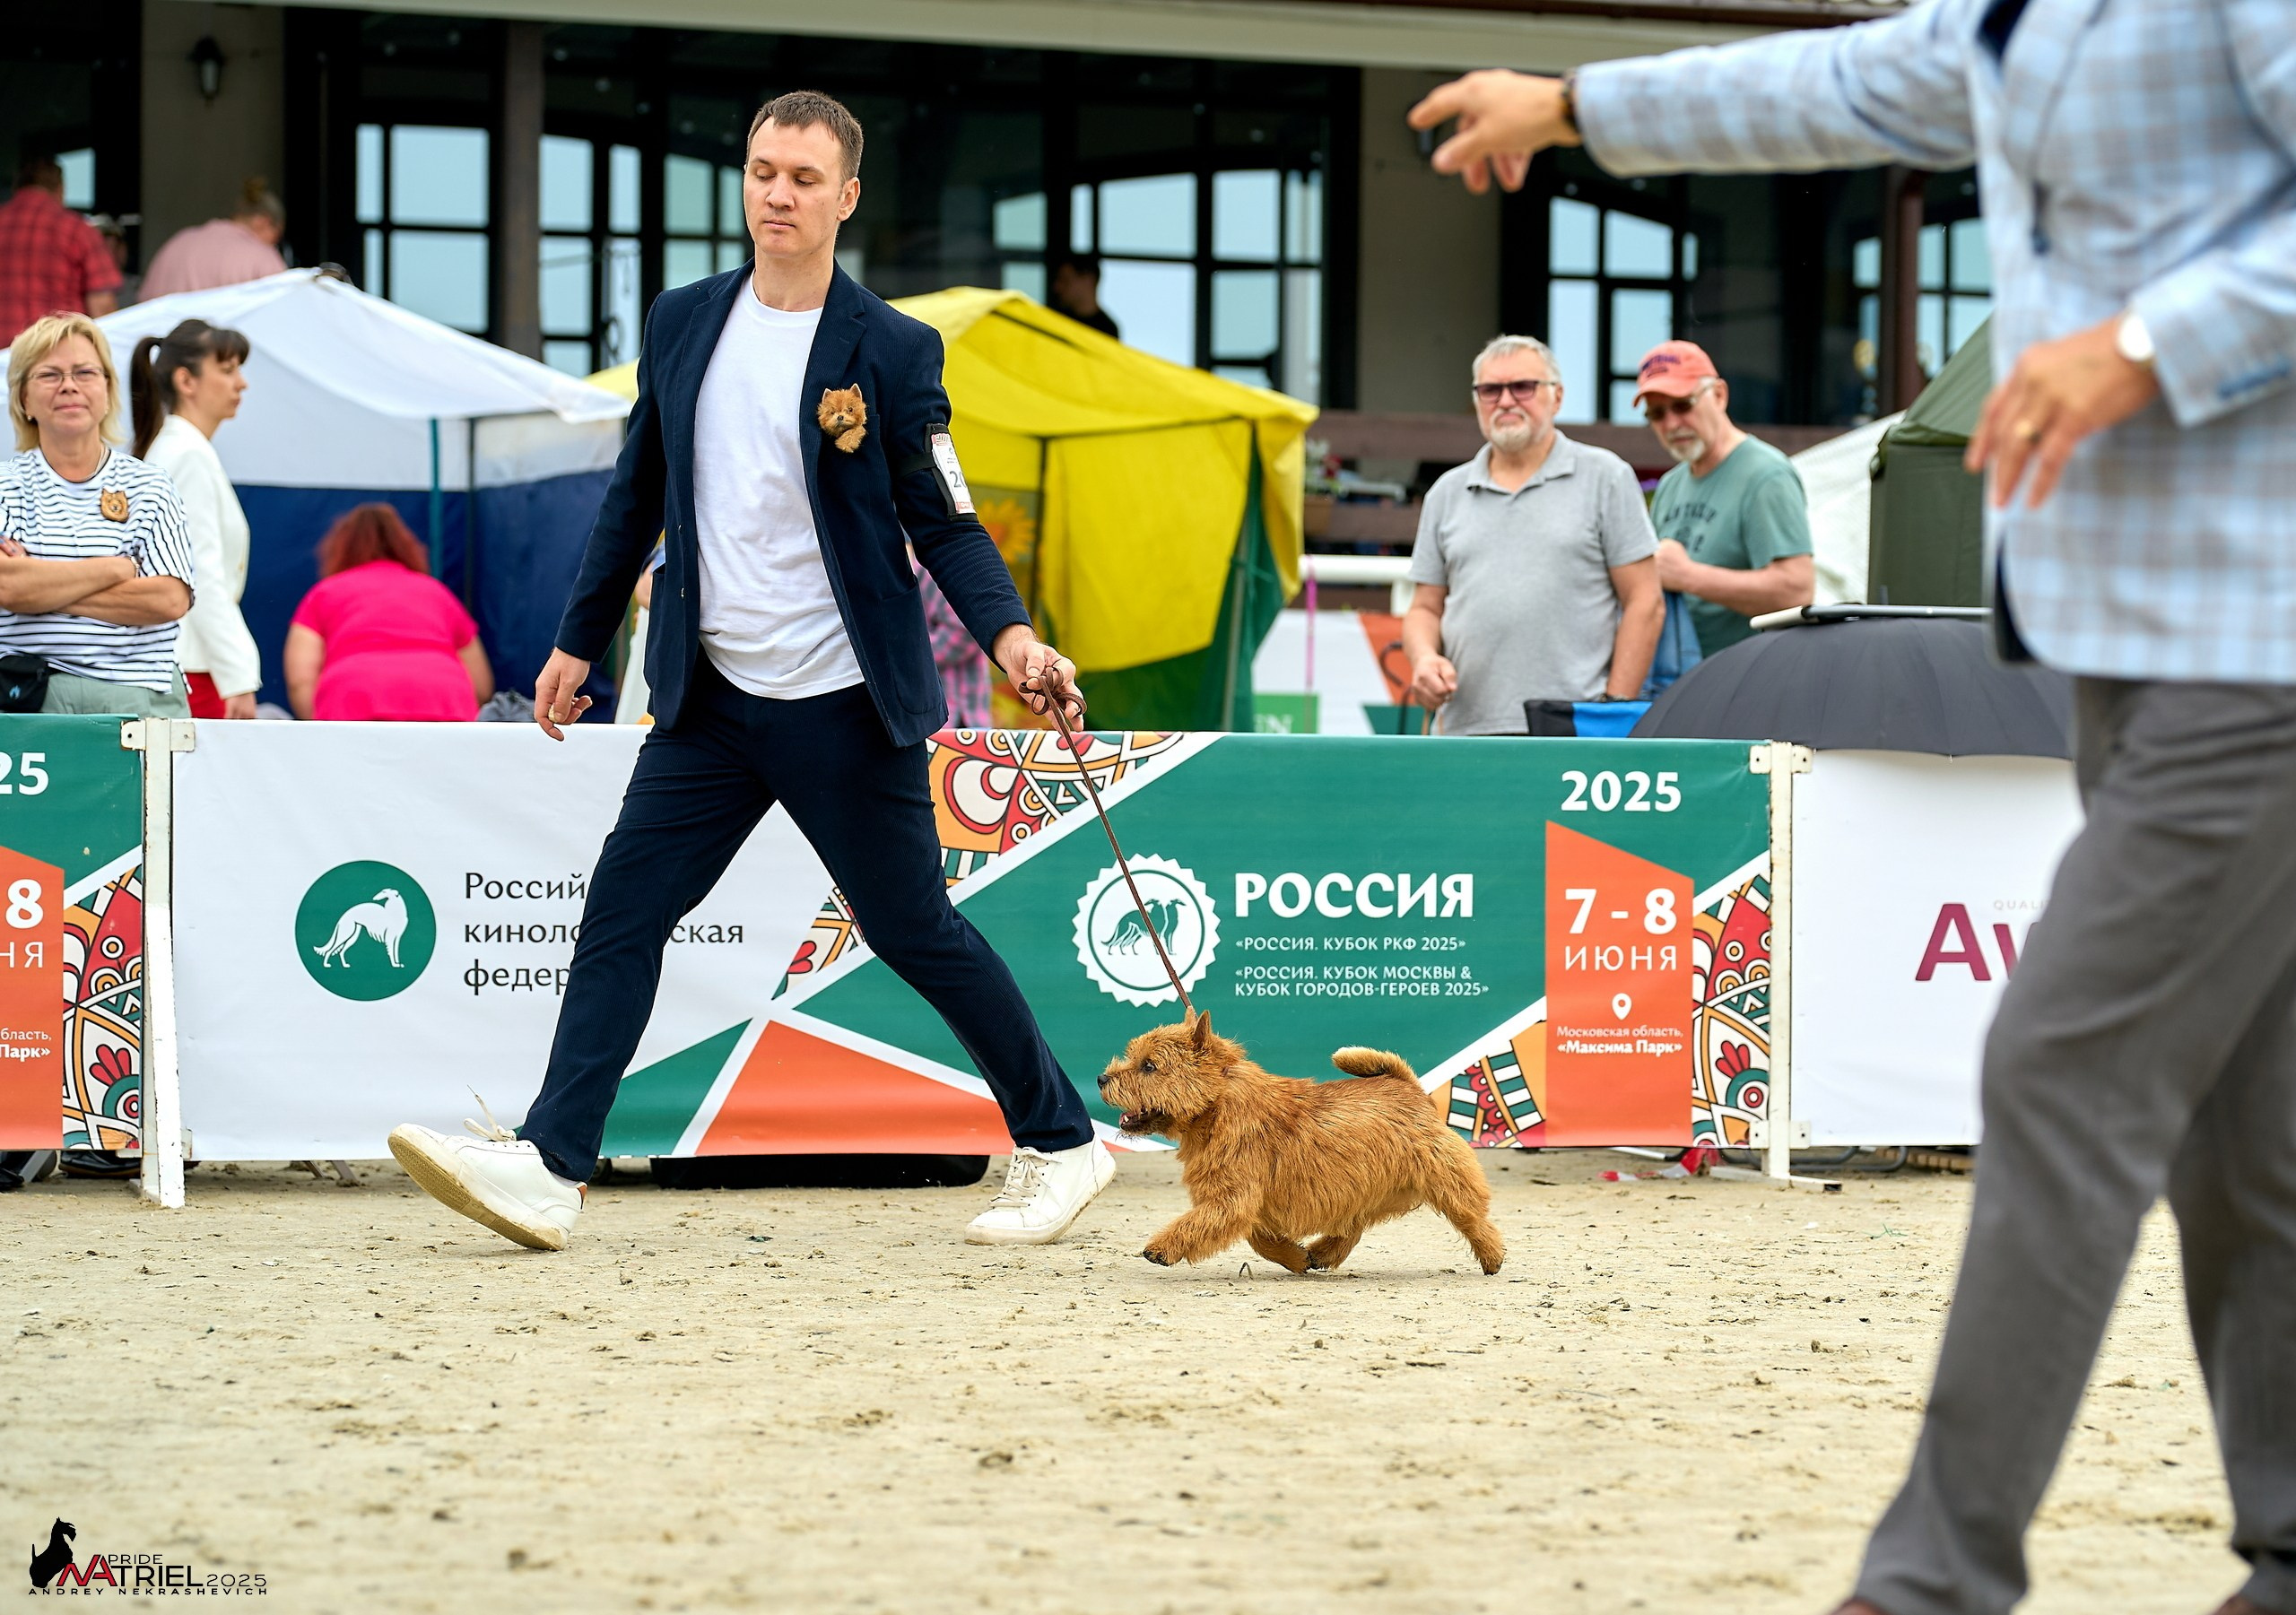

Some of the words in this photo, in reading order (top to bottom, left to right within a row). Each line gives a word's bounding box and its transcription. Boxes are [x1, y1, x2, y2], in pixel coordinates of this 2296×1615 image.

[1561, 770, 1682, 812] 2025
[465, 873, 585, 899] Россий
[1235, 873, 1474, 918] РОССИЯ
[5, 879, 44, 929] 8
[1564, 888, 1597, 934] 7
[1643, 888, 1677, 935] 8
[1235, 937, 1318, 951] «РОССИЯ.
[1324, 937, 1378, 951] КУБОК
[1383, 936, 1417, 951] РКФ
[1421, 936, 1466, 951] 2025»
[1564, 945, 1677, 971] ИЮНЯ
[464, 959, 571, 995] федер
[1235, 966, 1318, 980] «РОССИЯ.
[1323, 966, 1378, 980] КУБОК
[1383, 966, 1456, 980] МОСКВЫ
[1460, 966, 1472, 980] &
[1235, 983, 1291, 996] КУБОК
[1295, 983, 1440, 997] ГОРОДОВ-ГЕРОЕВ
[1445, 983, 1490, 996] 2025»
[1556, 1026, 1631, 1038] Московская
[1631, 1024, 1683, 1038] область,
[1557, 1040, 1634, 1054] «Максима
[1636, 1039, 1683, 1057] Парк»
